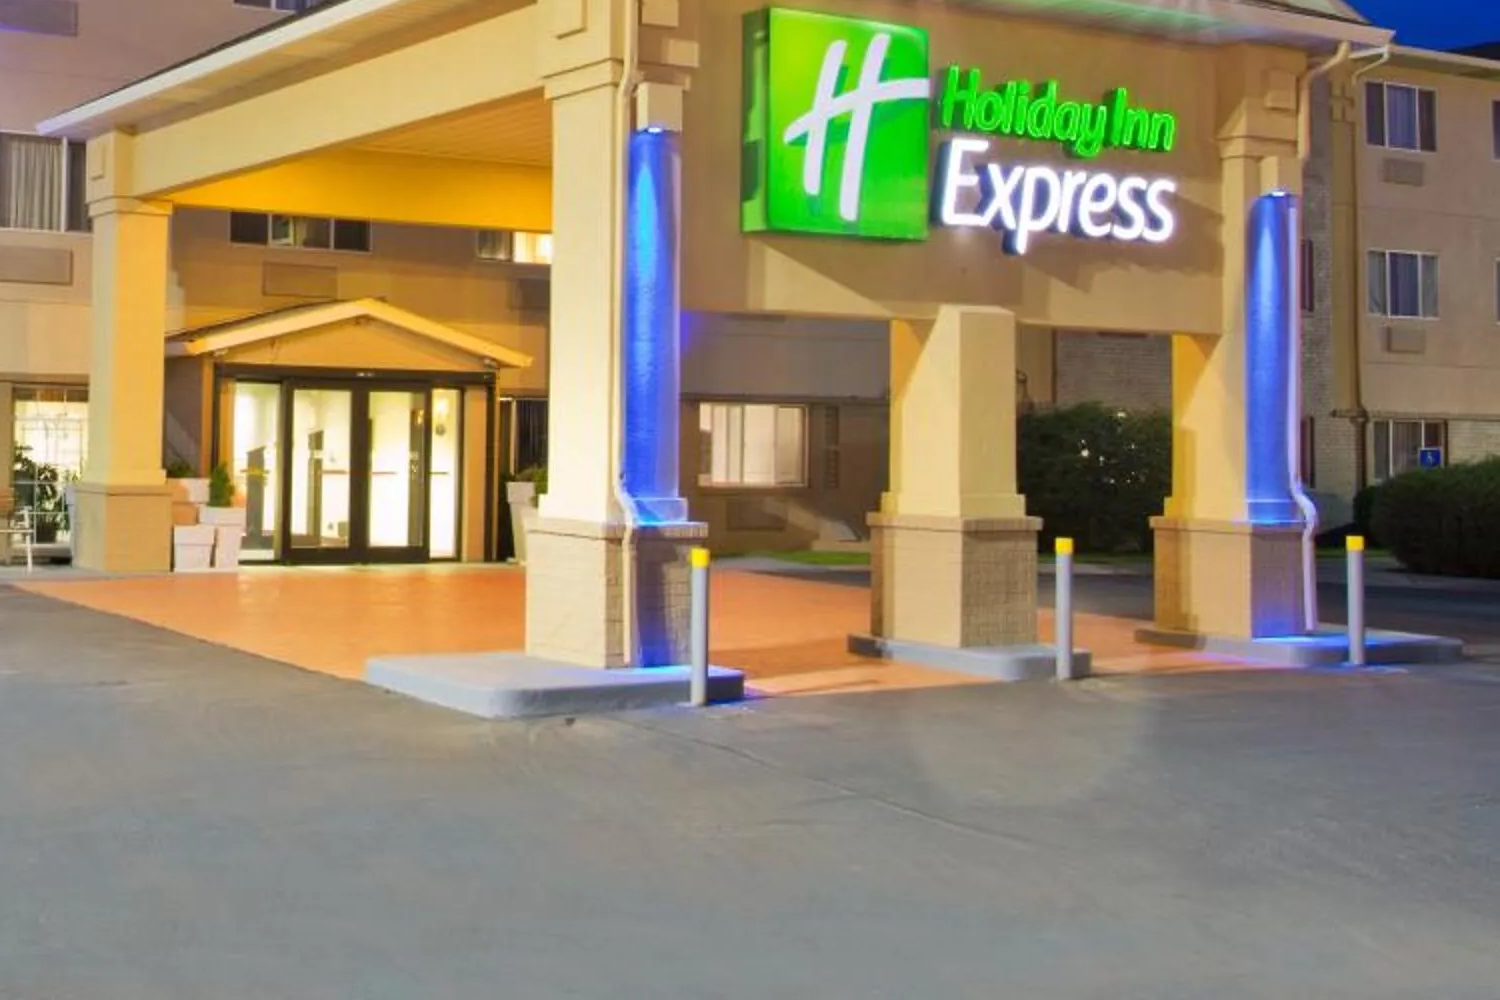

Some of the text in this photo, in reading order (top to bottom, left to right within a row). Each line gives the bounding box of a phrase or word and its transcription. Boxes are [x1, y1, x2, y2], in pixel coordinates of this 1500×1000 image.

[784, 33, 930, 221] H
[940, 65, 1176, 157] Holiday Inn
[941, 139, 1177, 254] Express
